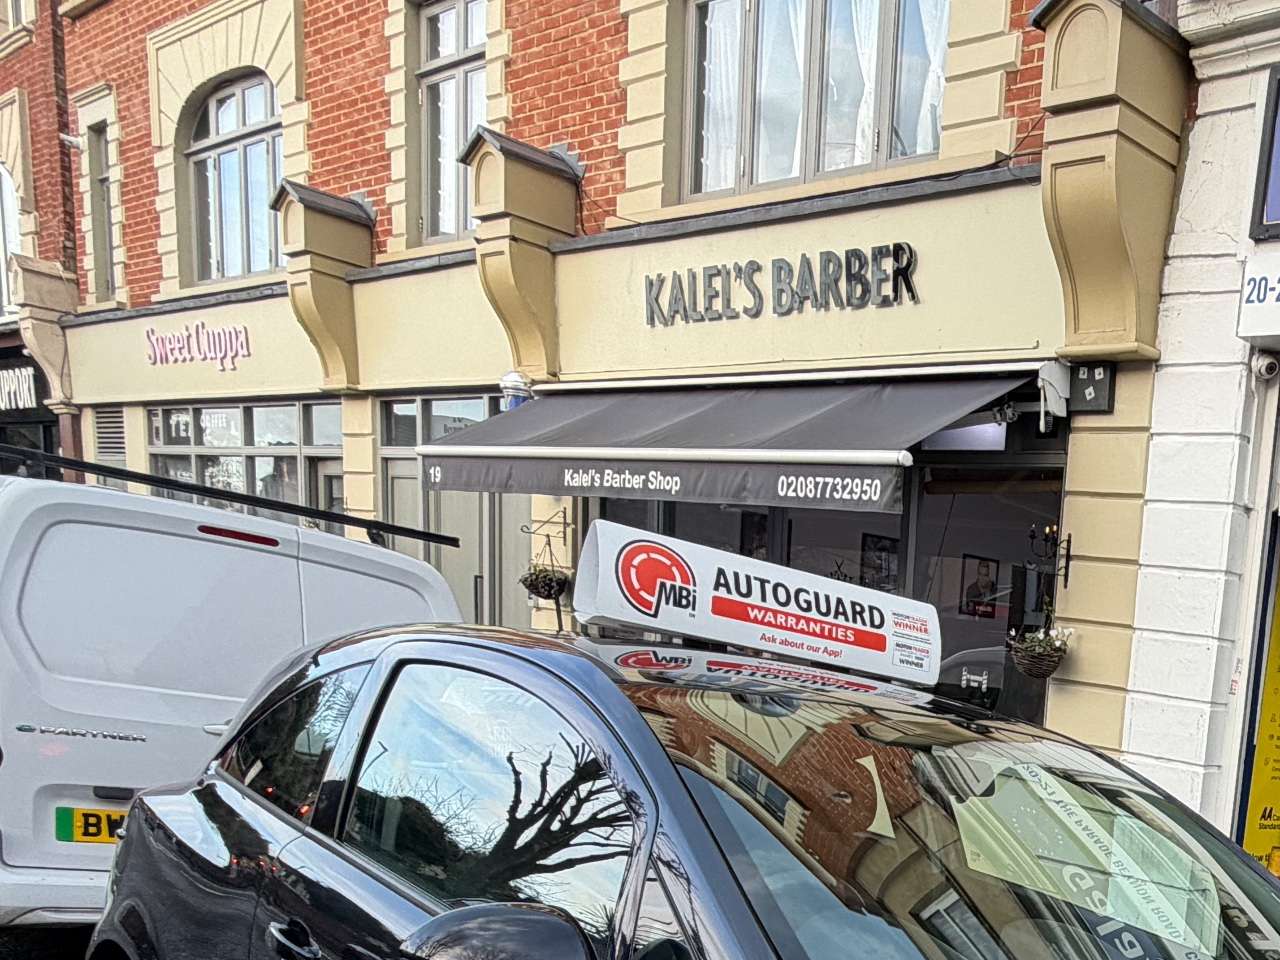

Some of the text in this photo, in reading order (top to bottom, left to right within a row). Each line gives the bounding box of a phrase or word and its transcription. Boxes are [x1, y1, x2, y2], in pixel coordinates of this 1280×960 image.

[645, 241, 921, 327] KALEL'S BARBER
[146, 320, 251, 371] Sweet Cuppa
[429, 466, 442, 483] 19
[564, 469, 881, 501] Kalel's Barber Shop 02087732950
[713, 567, 886, 630] AUTOGUARD
[746, 606, 855, 642] WARRANTIES
[894, 620, 928, 635] WINNER
[760, 633, 843, 658] Ask about our App!
[40, 725, 147, 743] PARTNER
